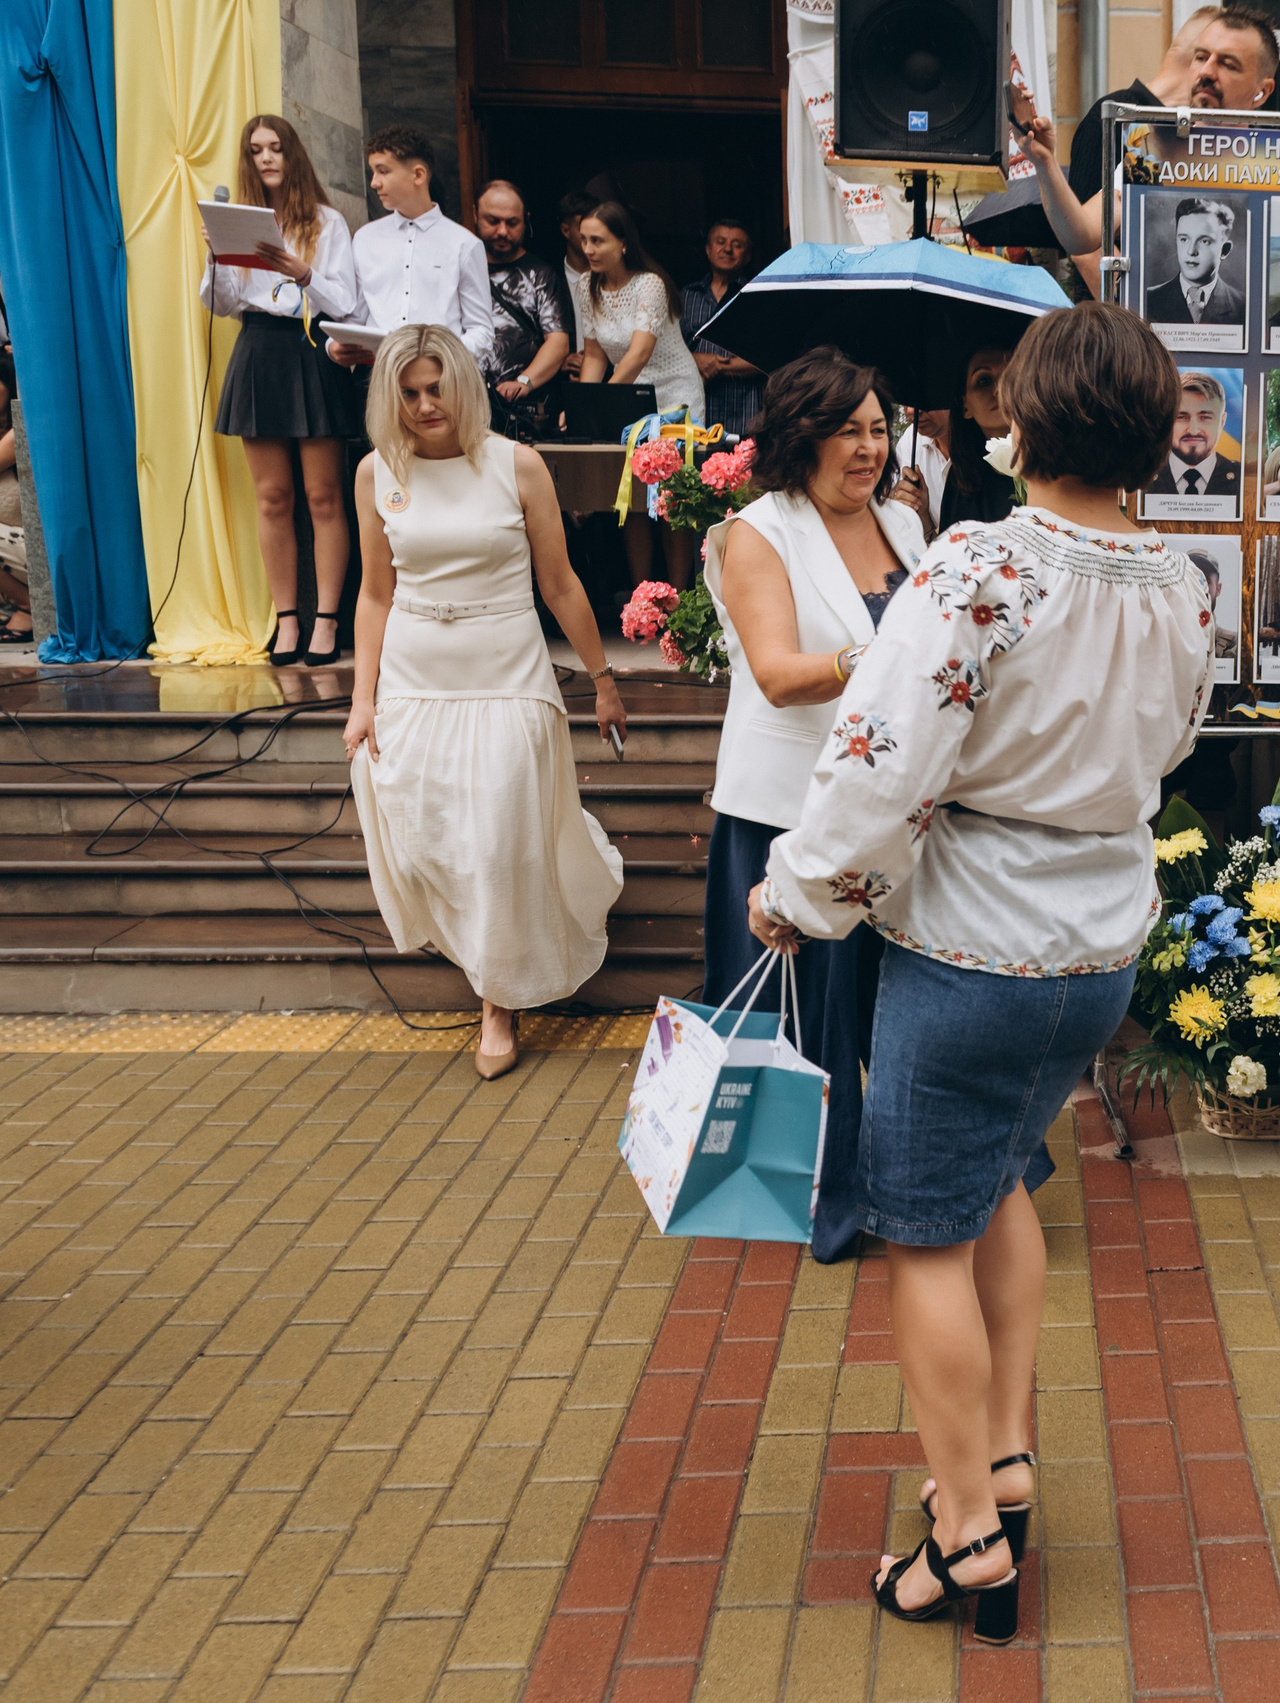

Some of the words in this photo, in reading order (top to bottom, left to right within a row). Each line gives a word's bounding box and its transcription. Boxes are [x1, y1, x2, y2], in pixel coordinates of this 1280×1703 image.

[1188, 132, 1258, 158] ГЕРОЇ
[1158, 161, 1219, 183] ДОКИ
[720, 1083, 753, 1096] UKRAINE
[715, 1096, 738, 1109] KYIV
